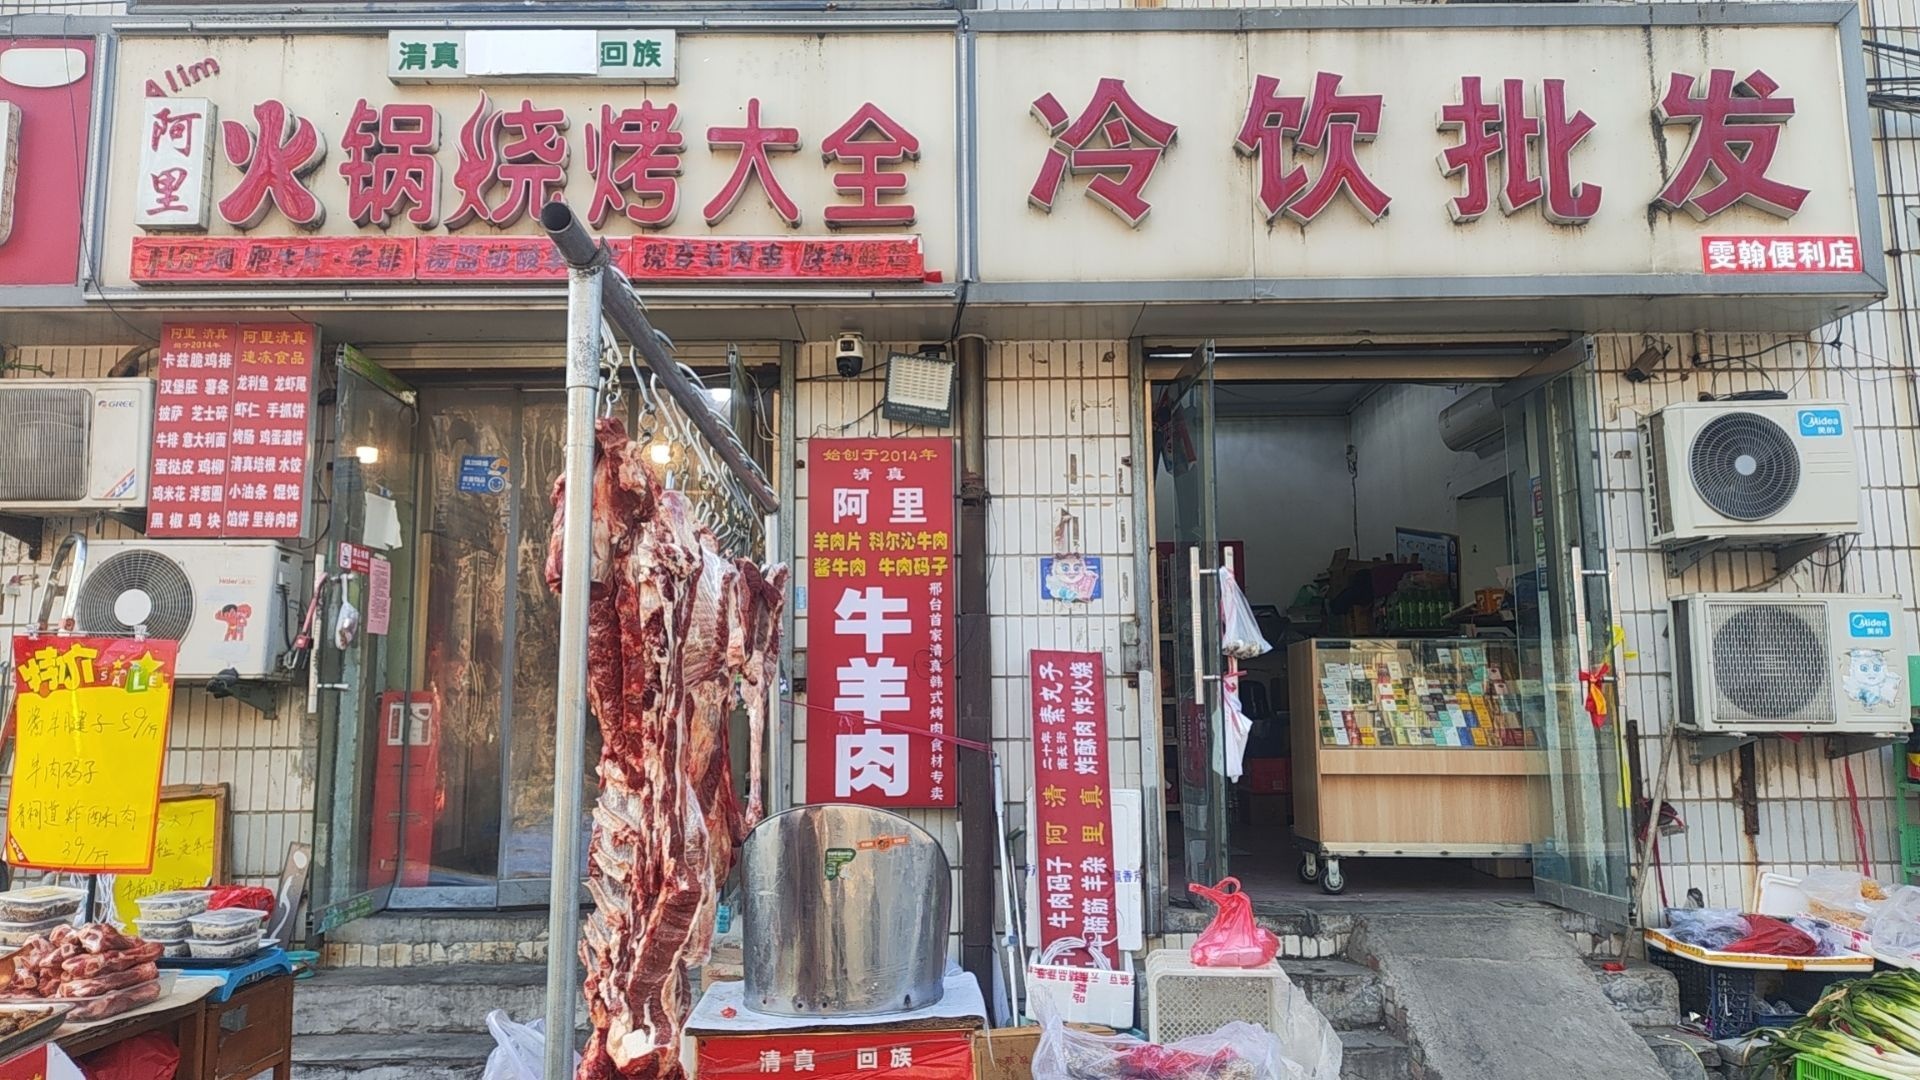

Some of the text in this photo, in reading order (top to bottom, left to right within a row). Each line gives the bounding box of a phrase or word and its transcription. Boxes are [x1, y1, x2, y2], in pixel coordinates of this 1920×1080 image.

[398, 39, 661, 71] 清真 回族
[145, 55, 220, 98] Alim
[1028, 69, 1811, 225] 冷饮批发
[146, 107, 201, 216] 阿里
[217, 90, 921, 228] 火锅烧烤大全
[1708, 240, 1854, 269] 雯翰便利店
[171, 328, 228, 340] 阿里 清真
[243, 330, 307, 345] 阿里清真
[241, 350, 305, 365] 速冻食品
[204, 378, 230, 395] 薯条
[236, 374, 307, 392] 龙利鱼 龙虾尾
[158, 405, 229, 422] 披萨 芝士碎
[234, 401, 305, 419] 虾仁 手抓饼
[156, 432, 227, 448] 牛排 意大利面
[232, 429, 303, 447] 烤肠 鸡蛋灌饼
[230, 456, 302, 473] 清真培根 水饺
[823, 449, 938, 462] 始创于2014年
[154, 459, 225, 475] 蛋挞皮 鸡柳
[853, 467, 906, 481] 清真
[152, 485, 186, 501] 鸡米花
[229, 483, 300, 500] 小油条 馄饨
[833, 487, 927, 524] 阿里
[227, 511, 298, 528] 馅饼 里脊肉饼
[814, 531, 948, 551] 羊肉片 科尔沁牛肉
[814, 556, 949, 577] 酱牛肉 牛肉码子
[18, 642, 98, 692] 特价
[834, 586, 912, 797] 牛羊肉
[928, 581, 944, 801] 邢台首家清真韩式烤肉食材专卖
[1039, 661, 1066, 770] 二十年 素丸子
[1070, 662, 1099, 775] 炸酥肉 炸火烧
[26, 753, 99, 789] 牛肉码子
[1080, 857, 1109, 892] 羊杂
[1046, 855, 1075, 929] 牛肉码子
[759, 1047, 913, 1073] 清真 回族
